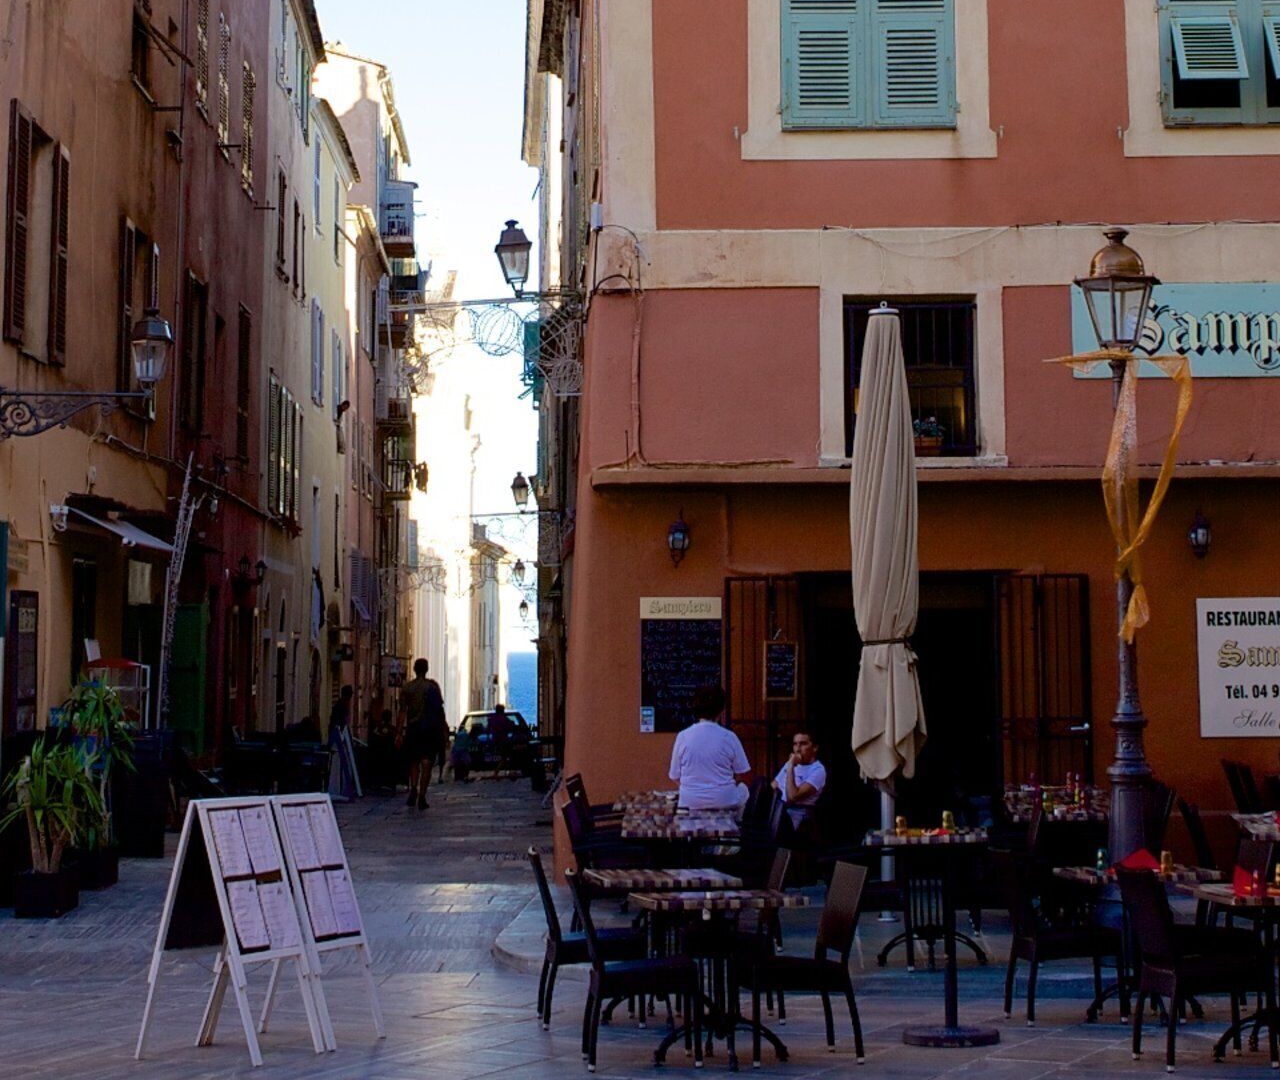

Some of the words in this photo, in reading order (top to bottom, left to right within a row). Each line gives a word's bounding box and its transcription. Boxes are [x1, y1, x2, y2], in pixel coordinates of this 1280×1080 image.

[1225, 684, 1249, 700] Tél.
[1252, 684, 1268, 699] 04
[1233, 708, 1277, 729] Salle
